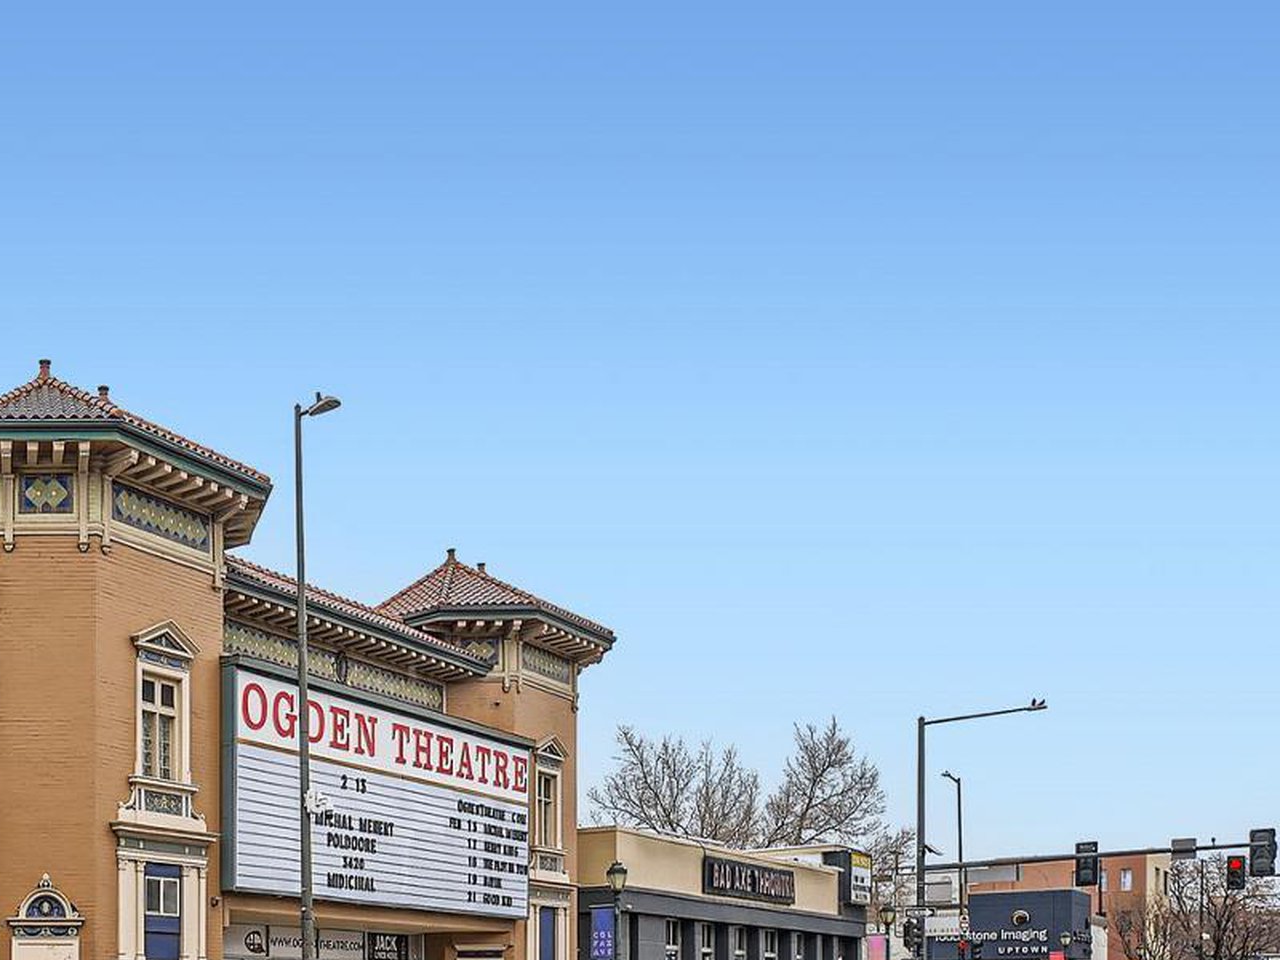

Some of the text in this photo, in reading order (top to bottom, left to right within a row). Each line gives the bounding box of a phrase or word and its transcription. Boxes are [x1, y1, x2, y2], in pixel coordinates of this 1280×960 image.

[241, 683, 528, 793] OGDEN THEATRE
[713, 862, 732, 889] BAD
[734, 865, 752, 892] AXE
[1001, 928, 1048, 942] Imaging
[998, 946, 1048, 954] UPTOWN
